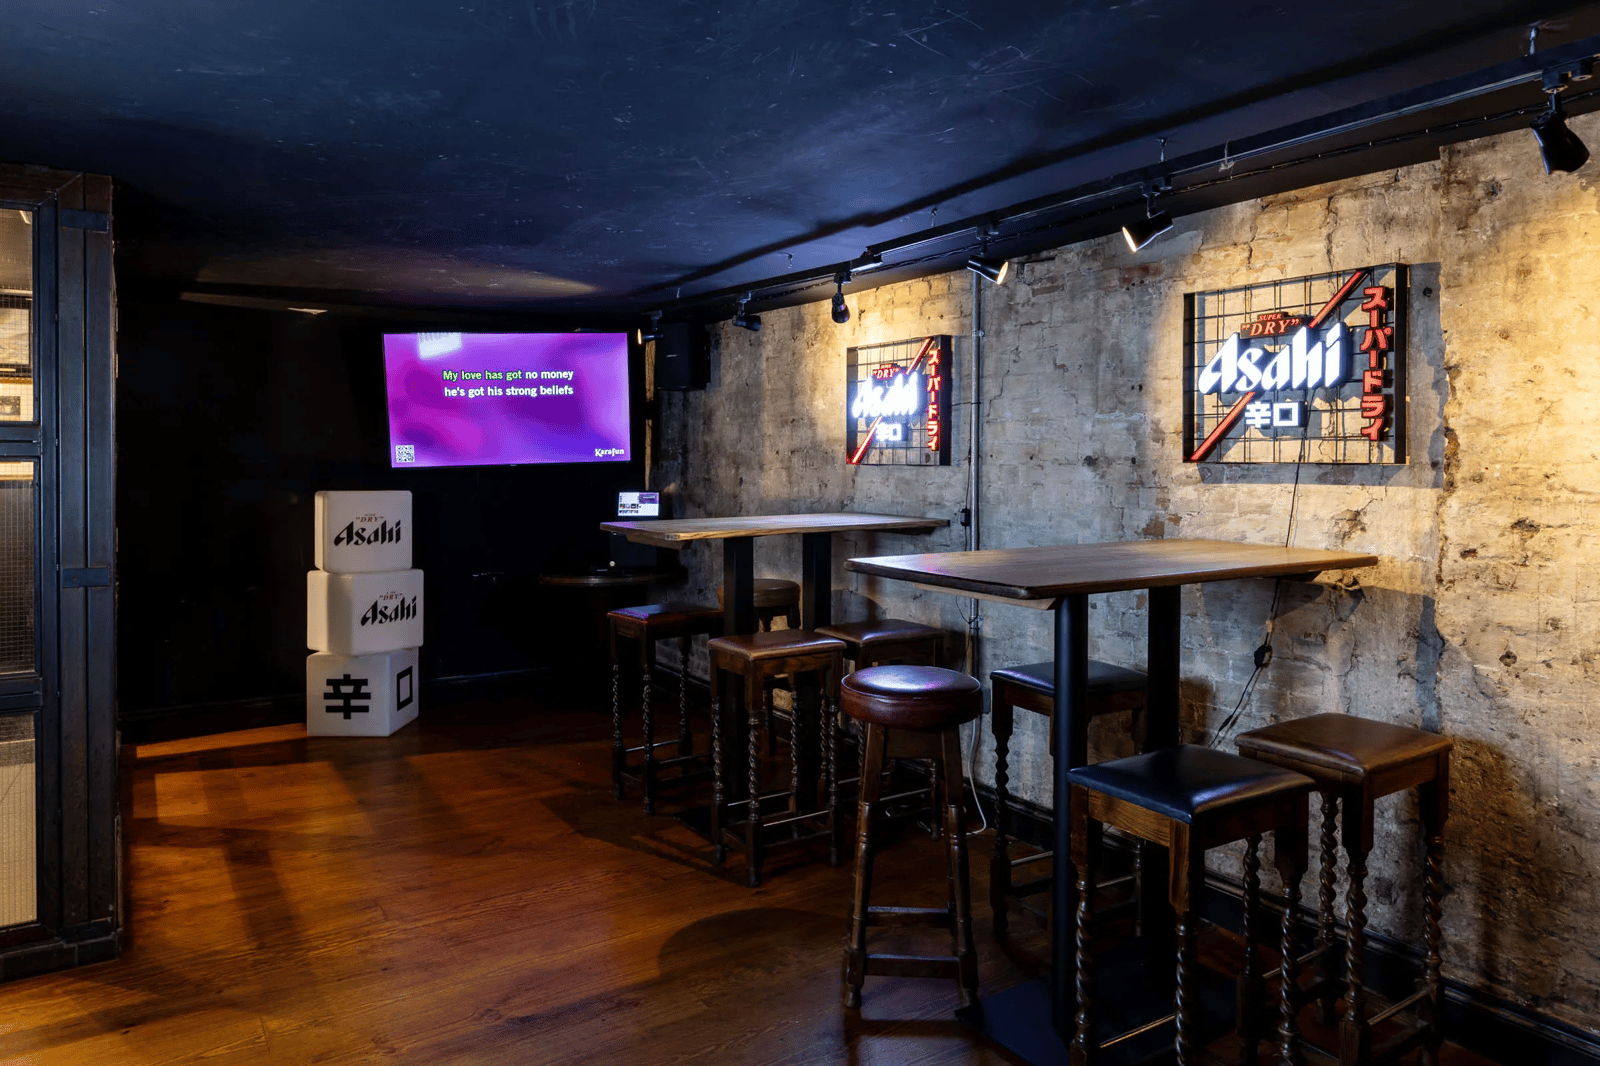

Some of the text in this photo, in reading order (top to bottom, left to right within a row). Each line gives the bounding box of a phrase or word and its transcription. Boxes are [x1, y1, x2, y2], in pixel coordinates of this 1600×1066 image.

[1257, 313, 1282, 321] SUPER
[1198, 321, 1341, 395] Asahi
[1360, 286, 1393, 441] スーパードライ
[443, 369, 574, 382] My love has got no money
[444, 385, 574, 398] he's got his strong beliefs
[1244, 400, 1299, 428] 辛口
[334, 519, 401, 546] Asahi
[360, 595, 417, 626] Asahi
